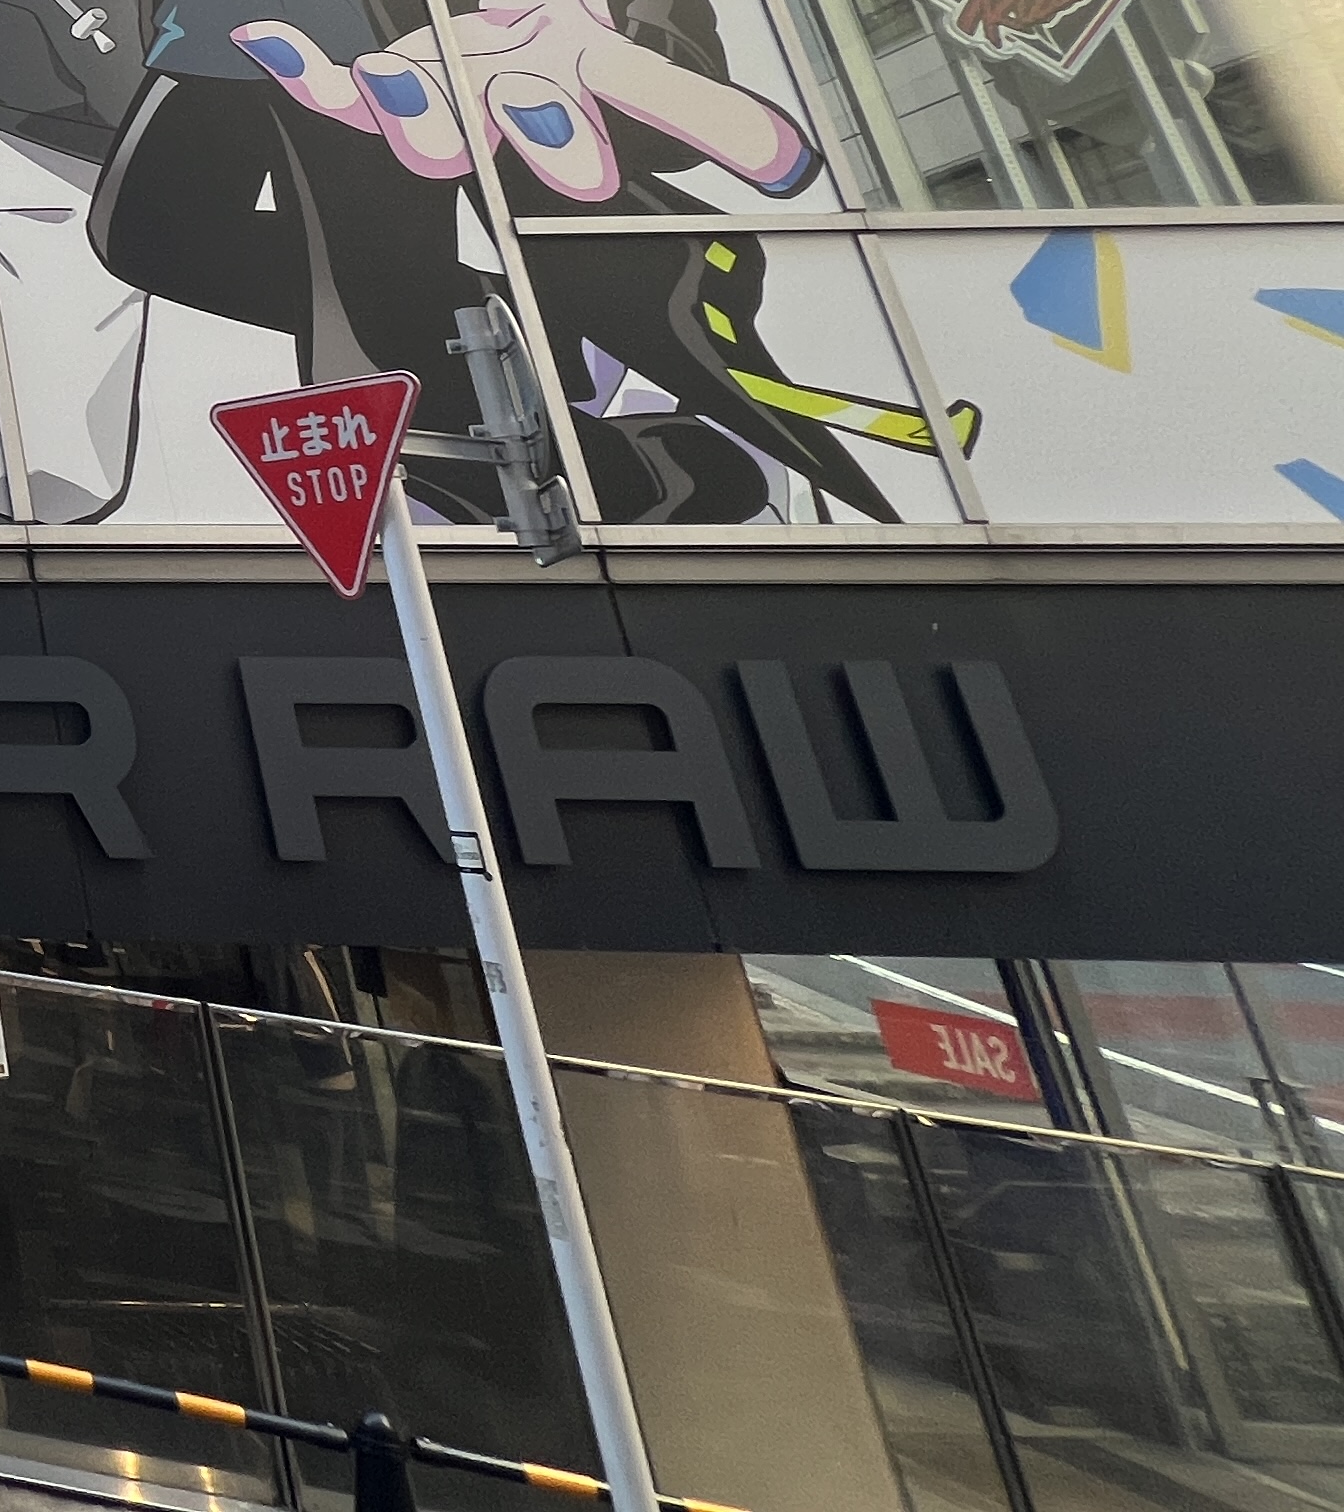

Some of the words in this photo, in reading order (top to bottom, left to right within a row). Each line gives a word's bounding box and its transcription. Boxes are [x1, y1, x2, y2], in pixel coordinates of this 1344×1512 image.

[260, 405, 377, 462] 止まれ
[287, 464, 368, 506] STOP
[238, 655, 1060, 874] RAW
